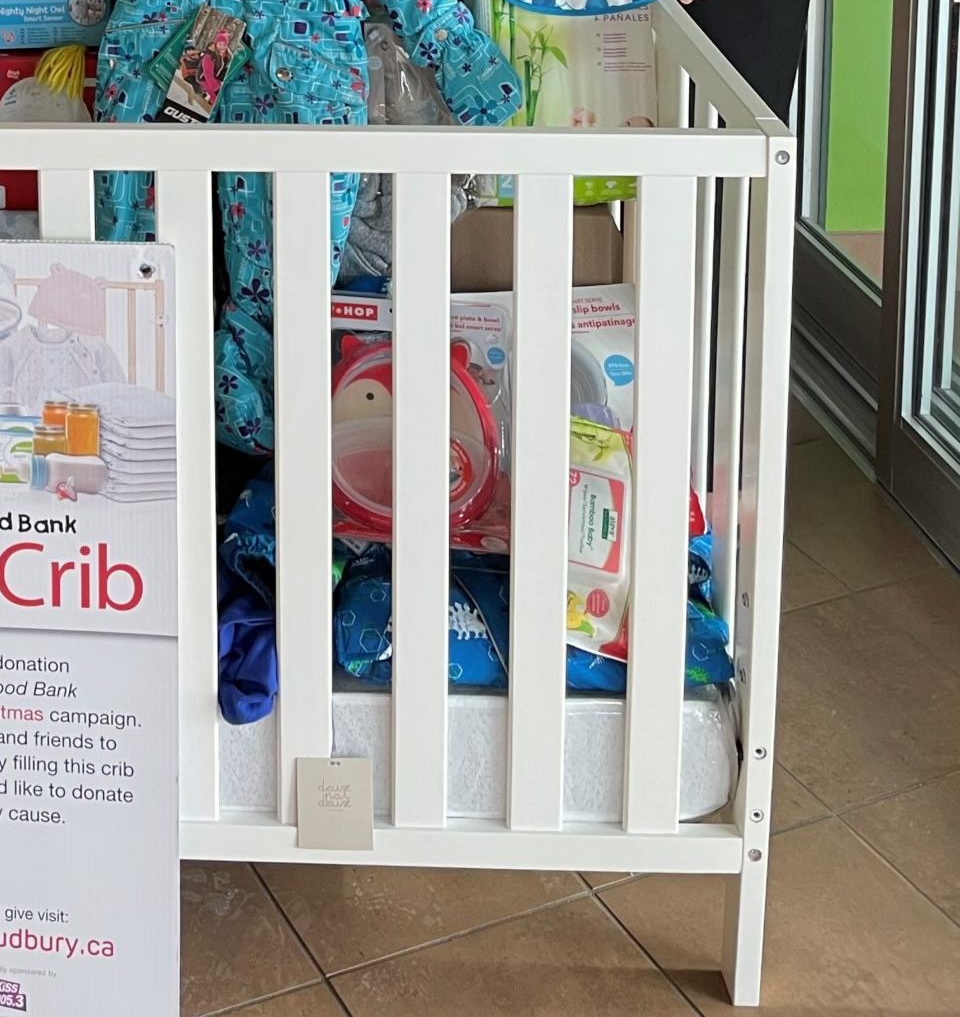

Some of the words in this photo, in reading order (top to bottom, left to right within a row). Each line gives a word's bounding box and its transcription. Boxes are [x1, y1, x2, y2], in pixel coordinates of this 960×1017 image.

[26, 5, 48, 15] Night
[50, 5, 65, 14] Owl
[344, 306, 375, 317] HOP
[591, 303, 620, 313] bowls
[588, 493, 597, 525] Bamboo
[18, 514, 76, 533] Bank
[33, 682, 77, 698] Bank
[50, 709, 141, 729] campaign.
[34, 731, 93, 749] friends
[100, 736, 116, 750] to
[13, 755, 57, 776] filling
[64, 759, 95, 774] this
[102, 762, 134, 777] crib
[15, 780, 43, 796] like
[49, 783, 65, 798] to
[72, 785, 133, 802] donate
[9, 809, 65, 823] cause.
[5, 906, 33, 922] give
[38, 908, 68, 923] visit:
